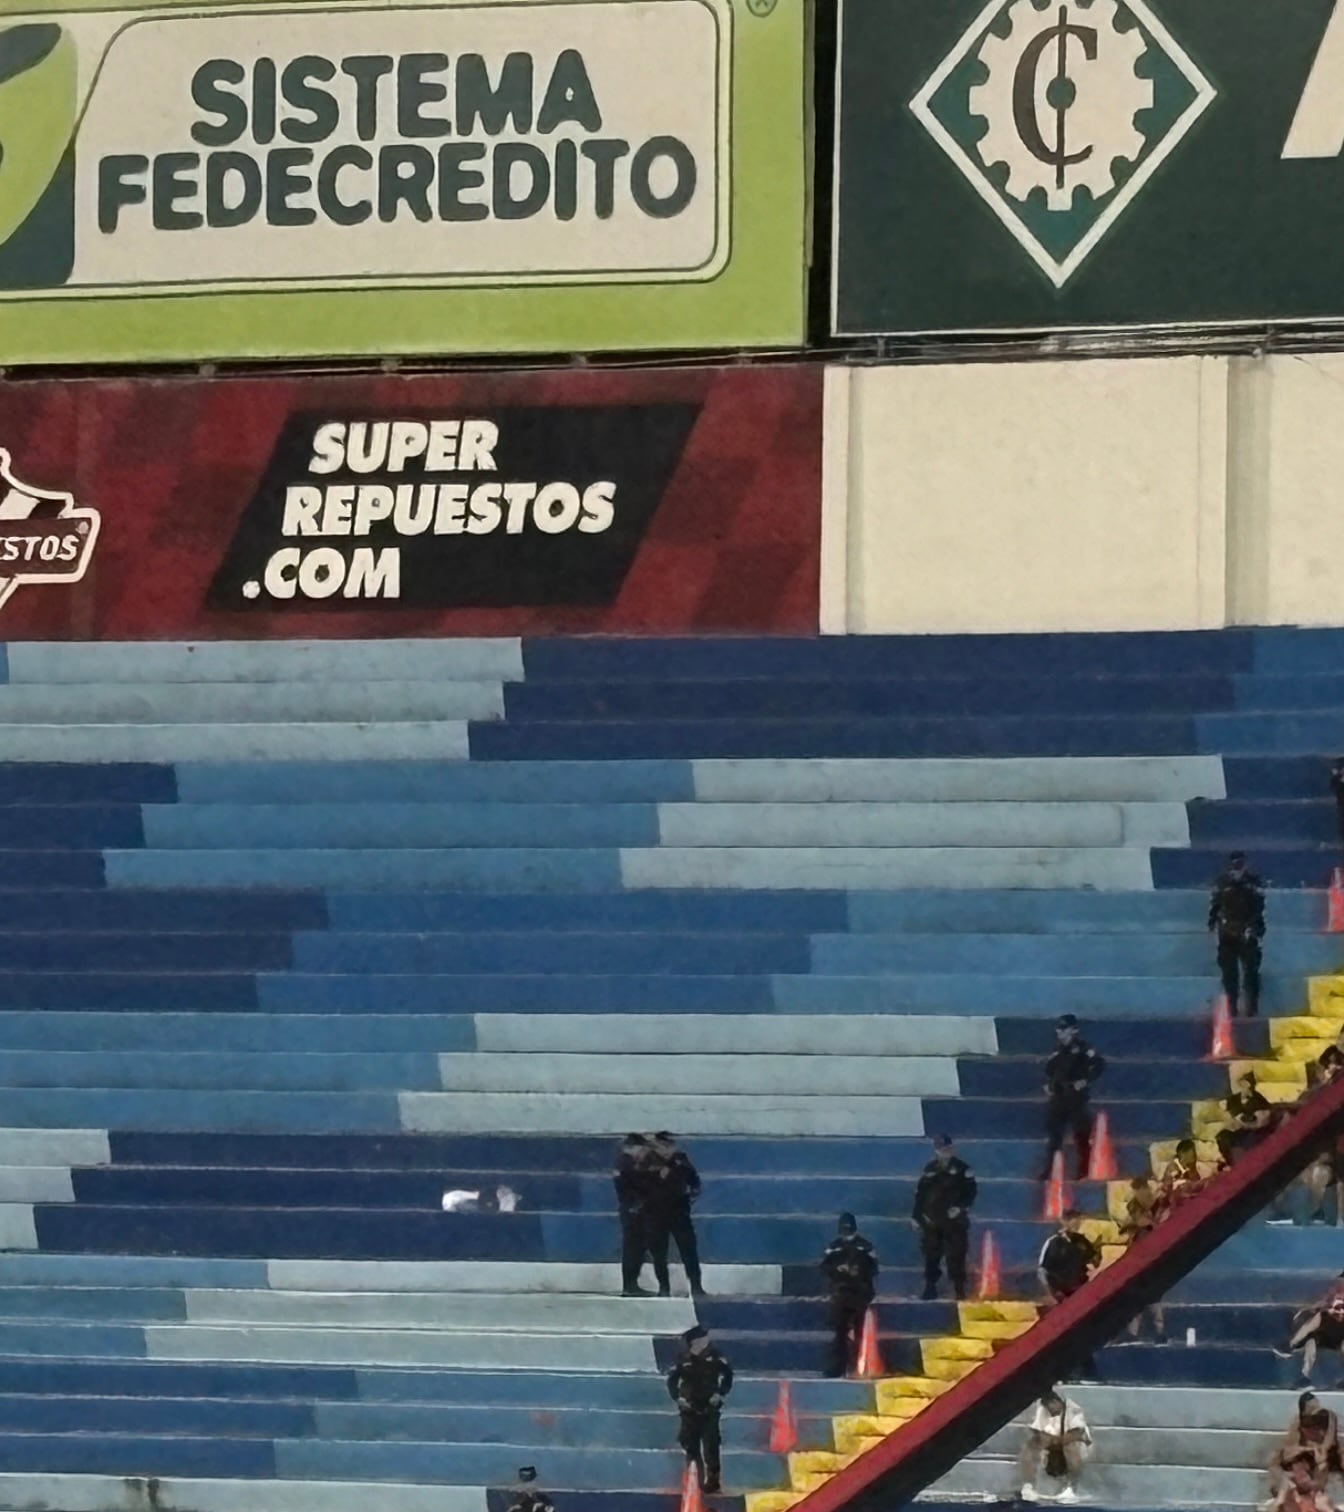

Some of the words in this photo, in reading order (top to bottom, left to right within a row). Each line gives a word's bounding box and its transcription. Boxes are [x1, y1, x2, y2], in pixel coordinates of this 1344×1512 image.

[190, 49, 602, 147] SISTEMA
[97, 134, 698, 235] FEDECREDITO
[307, 419, 499, 475] SUPER
[280, 480, 617, 538] REPUESTOS
[241, 547, 402, 600] .COM
